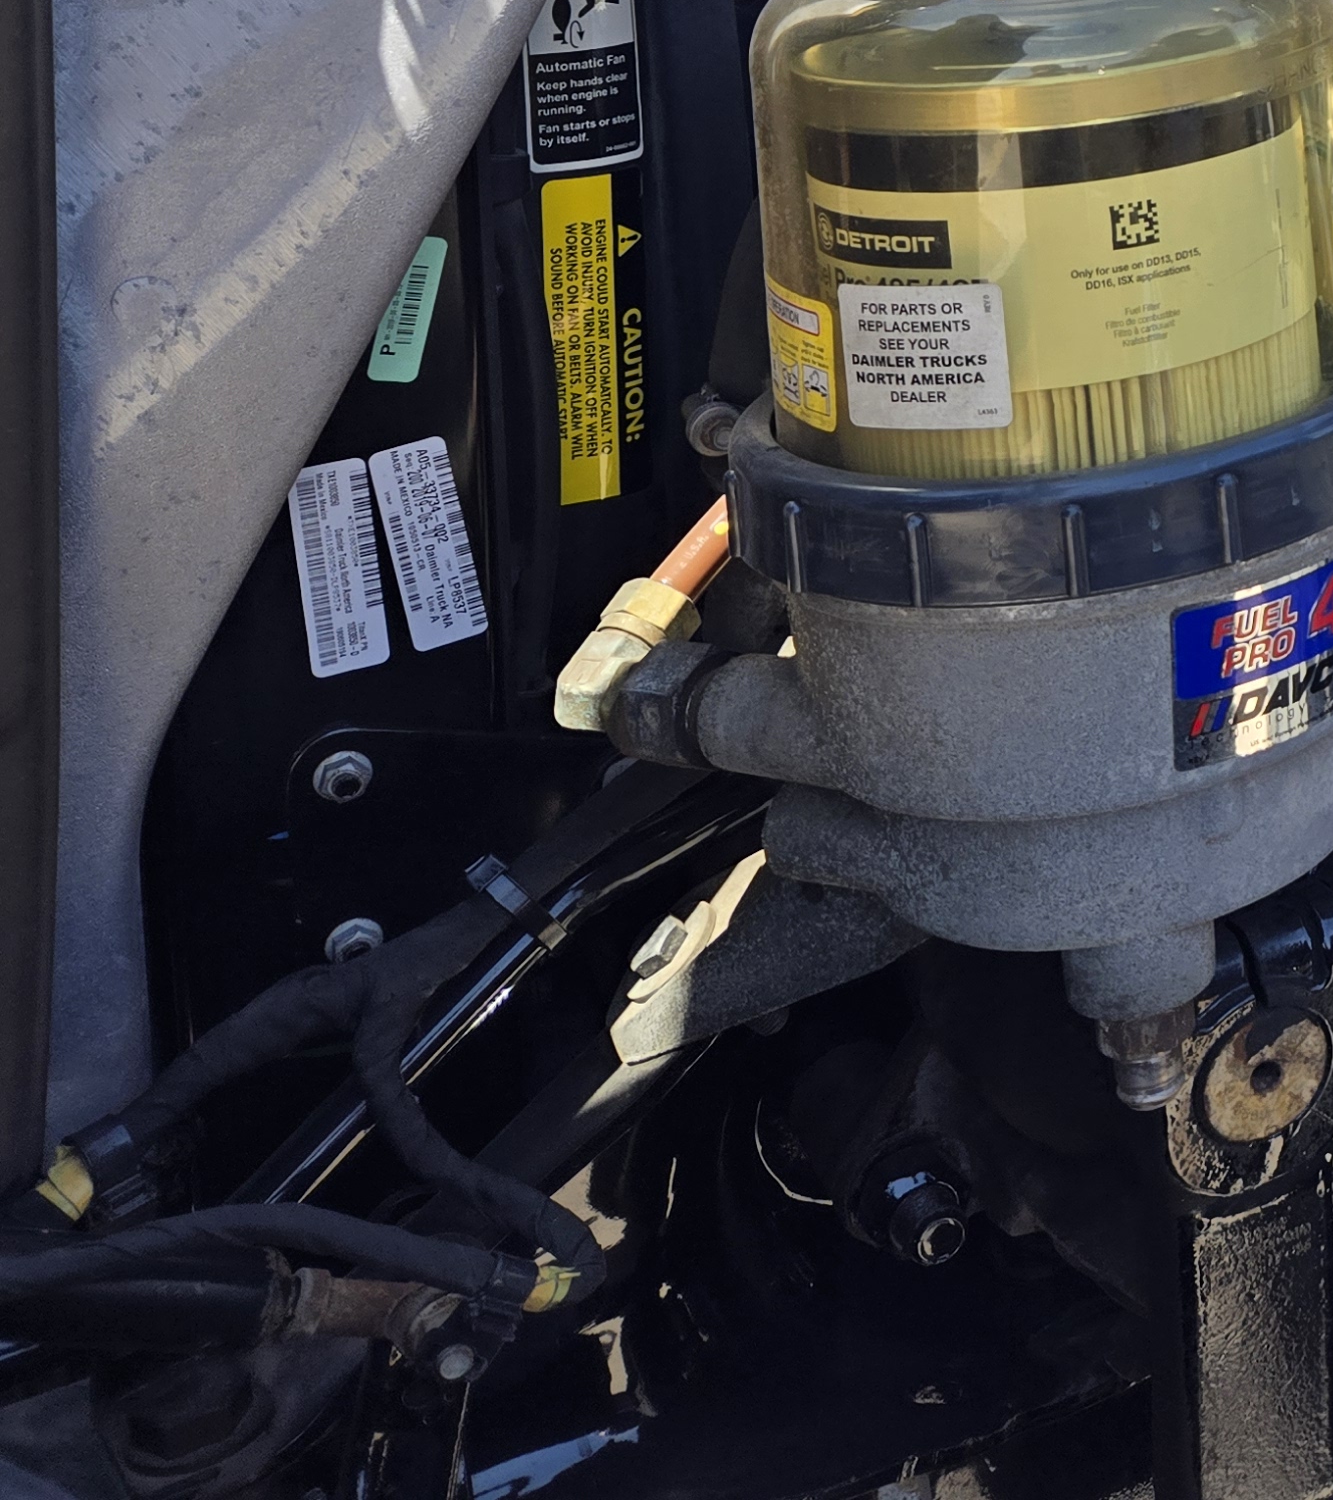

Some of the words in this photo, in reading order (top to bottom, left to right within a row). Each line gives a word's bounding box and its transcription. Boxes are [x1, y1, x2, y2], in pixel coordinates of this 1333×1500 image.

[535, 56, 604, 75] Automatic
[607, 53, 626, 65] Fan
[536, 79, 568, 92] Keep
[570, 76, 604, 88] hands
[605, 72, 628, 83] clear
[537, 90, 569, 103] when
[571, 88, 608, 103] engine
[610, 86, 619, 96] is
[538, 103, 586, 117] running.
[539, 123, 560, 134] Fan
[563, 120, 597, 132] starts
[598, 117, 610, 128] or
[612, 112, 636, 126] stops
[539, 137, 554, 148] by
[556, 131, 590, 145] itself.
[564, 223, 578, 280] WORKING
[580, 222, 592, 258] AVOID
[594, 218, 607, 262] ENGINE
[835, 227, 937, 255] DETROIT
[549, 247, 562, 290] SOUND
[1070, 269, 1094, 279] Only
[1096, 267, 1109, 276] for
[1112, 265, 1129, 274] use
[1131, 262, 1144, 270] on
[1146, 255, 1174, 267] DD13,
[1175, 248, 1202, 261] DD15,
[1086, 279, 1116, 290] DD16,
[1118, 275, 1134, 286] ISX
[1136, 264, 1191, 282] applications
[566, 284, 578, 303] ON
[580, 261, 594, 302] INJURY,
[596, 264, 608, 303] COULD
[550, 294, 564, 336] BEFORE
[567, 306, 579, 329] FAN
[583, 306, 594, 338] TURN
[597, 306, 609, 339] START
[861, 303, 888, 315] FOR
[892, 303, 936, 315] PARTS
[941, 303, 963, 314] OR
[1125, 306, 1141, 316] Fuel
[1143, 303, 1161, 312] Filter
[859, 319, 971, 332] REPLACEMENTS
[379, 344, 396, 357] P
[568, 333, 580, 351] OR
[879, 338, 905, 350] SEE
[908, 338, 950, 350] YOUR
[552, 340, 567, 404] AUTOMATIC
[568, 354, 581, 387] BELTS.
[584, 341, 597, 394] IGNITION
[621, 307, 645, 443] CAUTION:
[851, 353, 916, 369] DAIMLER
[919, 352, 988, 367] TRUCKS
[599, 343, 613, 436] AUTOMATICALLY.
[855, 370, 907, 385] NORTH
[910, 370, 985, 385] AMERICA
[569, 391, 582, 430] ALARM
[586, 397, 597, 418] OFF
[890, 390, 947, 404] DEALER
[571, 433, 583, 459] WILL
[586, 422, 598, 458] WHEN
[601, 440, 612, 455] TO
[389, 449, 401, 473] MADE
[398, 485, 412, 517] MEXICO
[333, 527, 346, 552] Daimler
[342, 588, 354, 614] America
[423, 543, 443, 582] Daimler
[433, 583, 449, 612] Truck
[441, 612, 453, 628] NA
[447, 575, 466, 616] LP8537
[1211, 595, 1298, 648] FUEL
[1221, 626, 1297, 678] PRO
